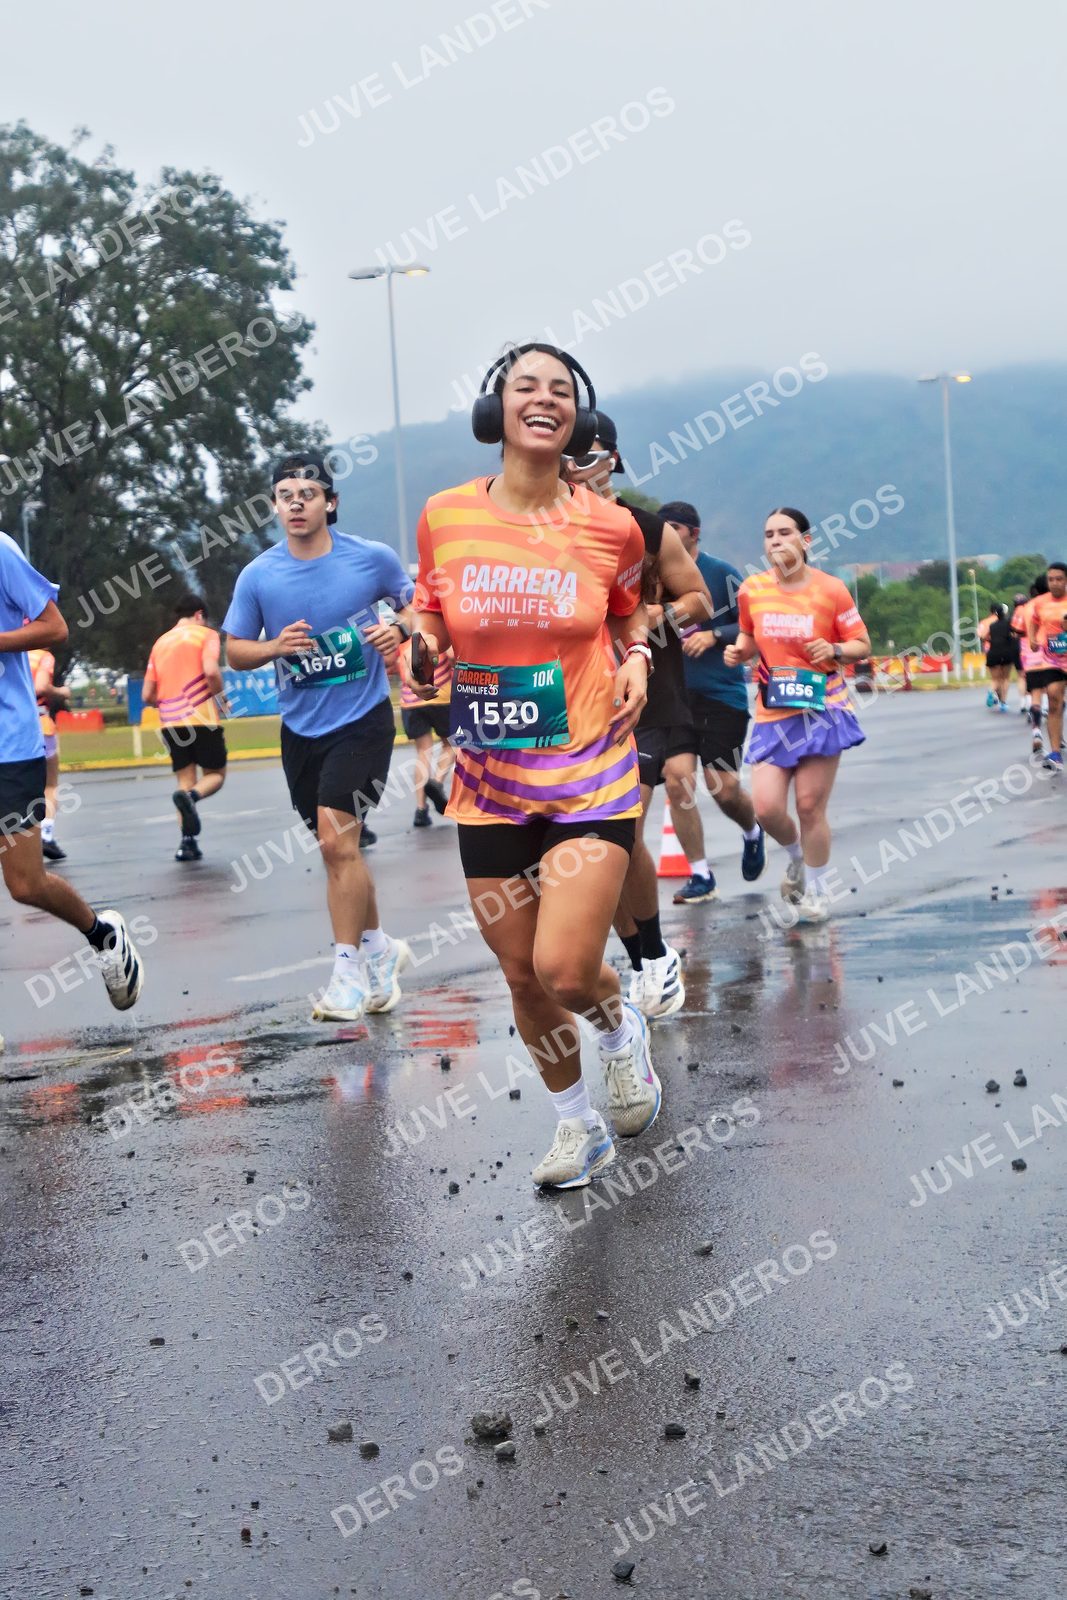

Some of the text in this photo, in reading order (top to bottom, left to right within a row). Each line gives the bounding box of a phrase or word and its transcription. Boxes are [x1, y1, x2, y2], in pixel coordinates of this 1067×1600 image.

[461, 564, 577, 597] CARRERA
[460, 597, 549, 616] OMNILIFE
[338, 632, 352, 644] 10K
[301, 653, 346, 673] 1676
[457, 670, 499, 685] CARRERA
[533, 669, 555, 688] 10K
[457, 684, 488, 695] OMNILIFE
[778, 683, 814, 698] 1656
[468, 701, 539, 725] 1520
